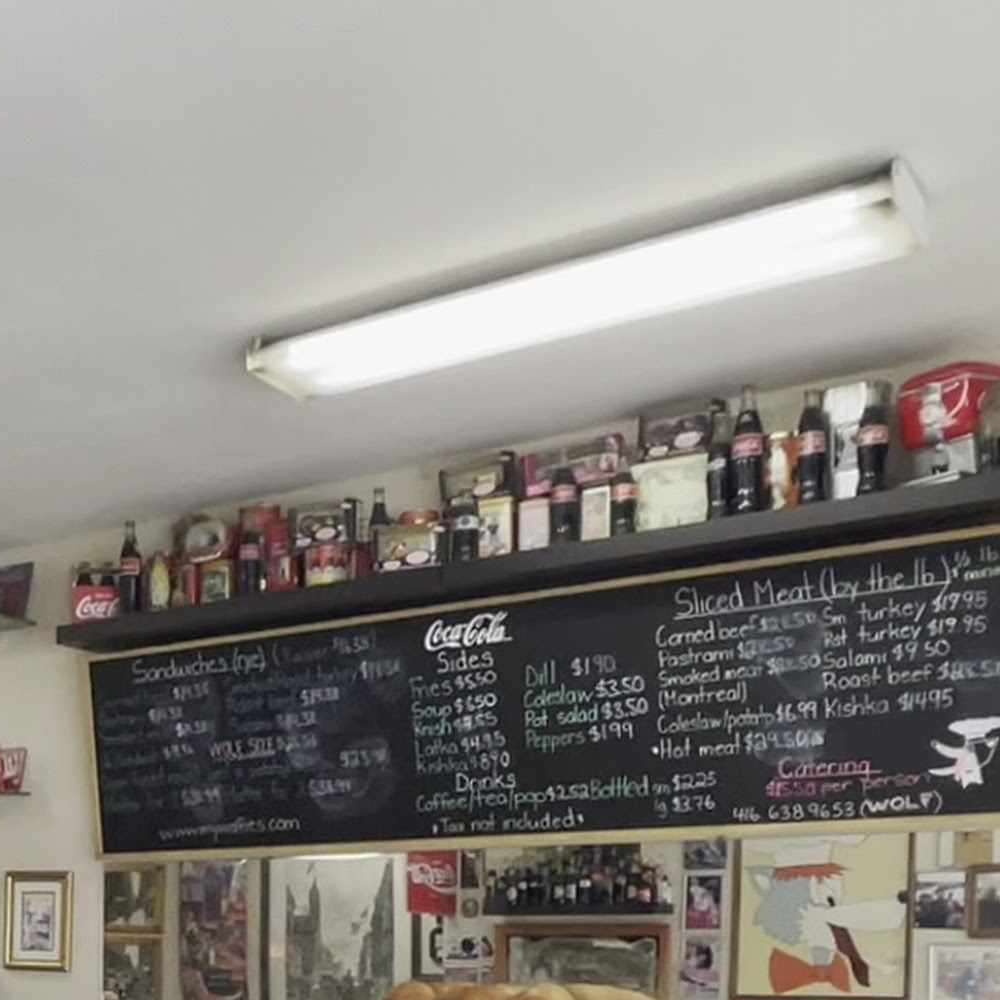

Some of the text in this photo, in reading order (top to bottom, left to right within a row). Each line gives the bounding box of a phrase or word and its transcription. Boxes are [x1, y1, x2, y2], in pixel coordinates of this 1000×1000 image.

[673, 580, 745, 619] Sliced
[752, 570, 814, 605] Meat
[866, 562, 905, 592] the
[858, 597, 927, 622] turkey
[858, 622, 922, 644] turkey
[437, 649, 495, 674] Sides
[822, 647, 888, 670] Salami
[524, 659, 556, 688] Dill
[822, 666, 882, 691] Roast
[657, 680, 748, 711] (Montreal)
[411, 701, 453, 720] Soup
[556, 702, 599, 726] salad
[660, 737, 691, 760] Hot
[699, 732, 741, 756] meat
[778, 757, 871, 780] Catering
[454, 771, 517, 793] Drinks
[470, 811, 496, 832] not
[733, 805, 762, 824] 416
